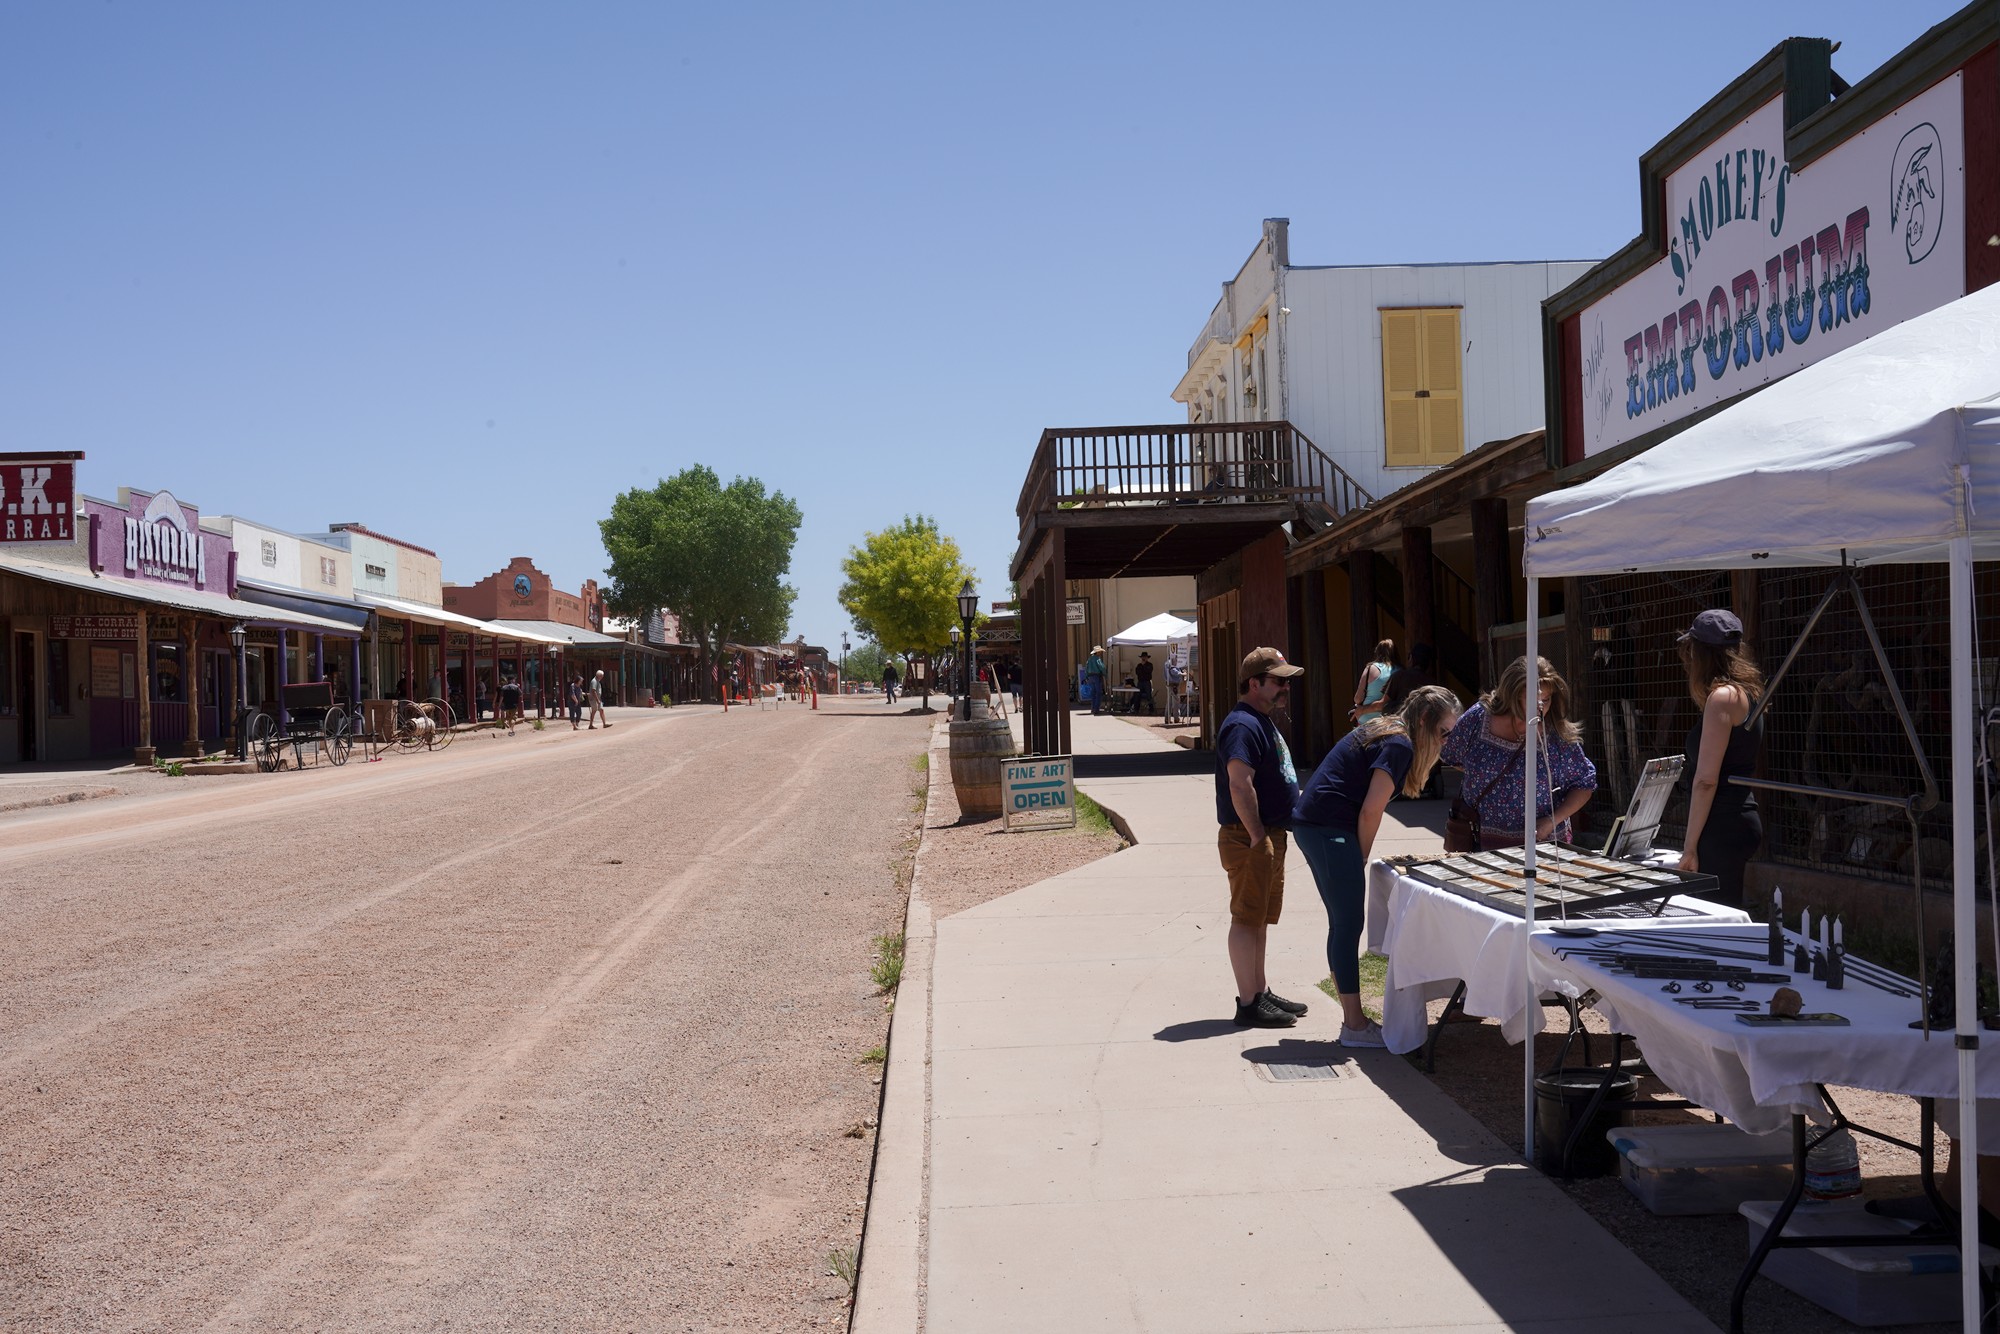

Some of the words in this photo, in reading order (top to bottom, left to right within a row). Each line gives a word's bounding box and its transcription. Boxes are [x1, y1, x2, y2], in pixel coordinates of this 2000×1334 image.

[1670, 148, 1791, 296] SMOKEY'S
[1623, 205, 1870, 420] EMPORIUM
[1583, 313, 1605, 399] Wild
[0, 467, 66, 516] .K.
[125, 516, 206, 584] HISTORAMA
[74, 628, 118, 637] GUNFIGHT
[121, 629, 138, 638] SIT
[75, 618, 95, 627] O.K.
[1008, 766, 1036, 780] FINE
[1042, 763, 1066, 777] ART
[1014, 791, 1066, 809] OPEN
